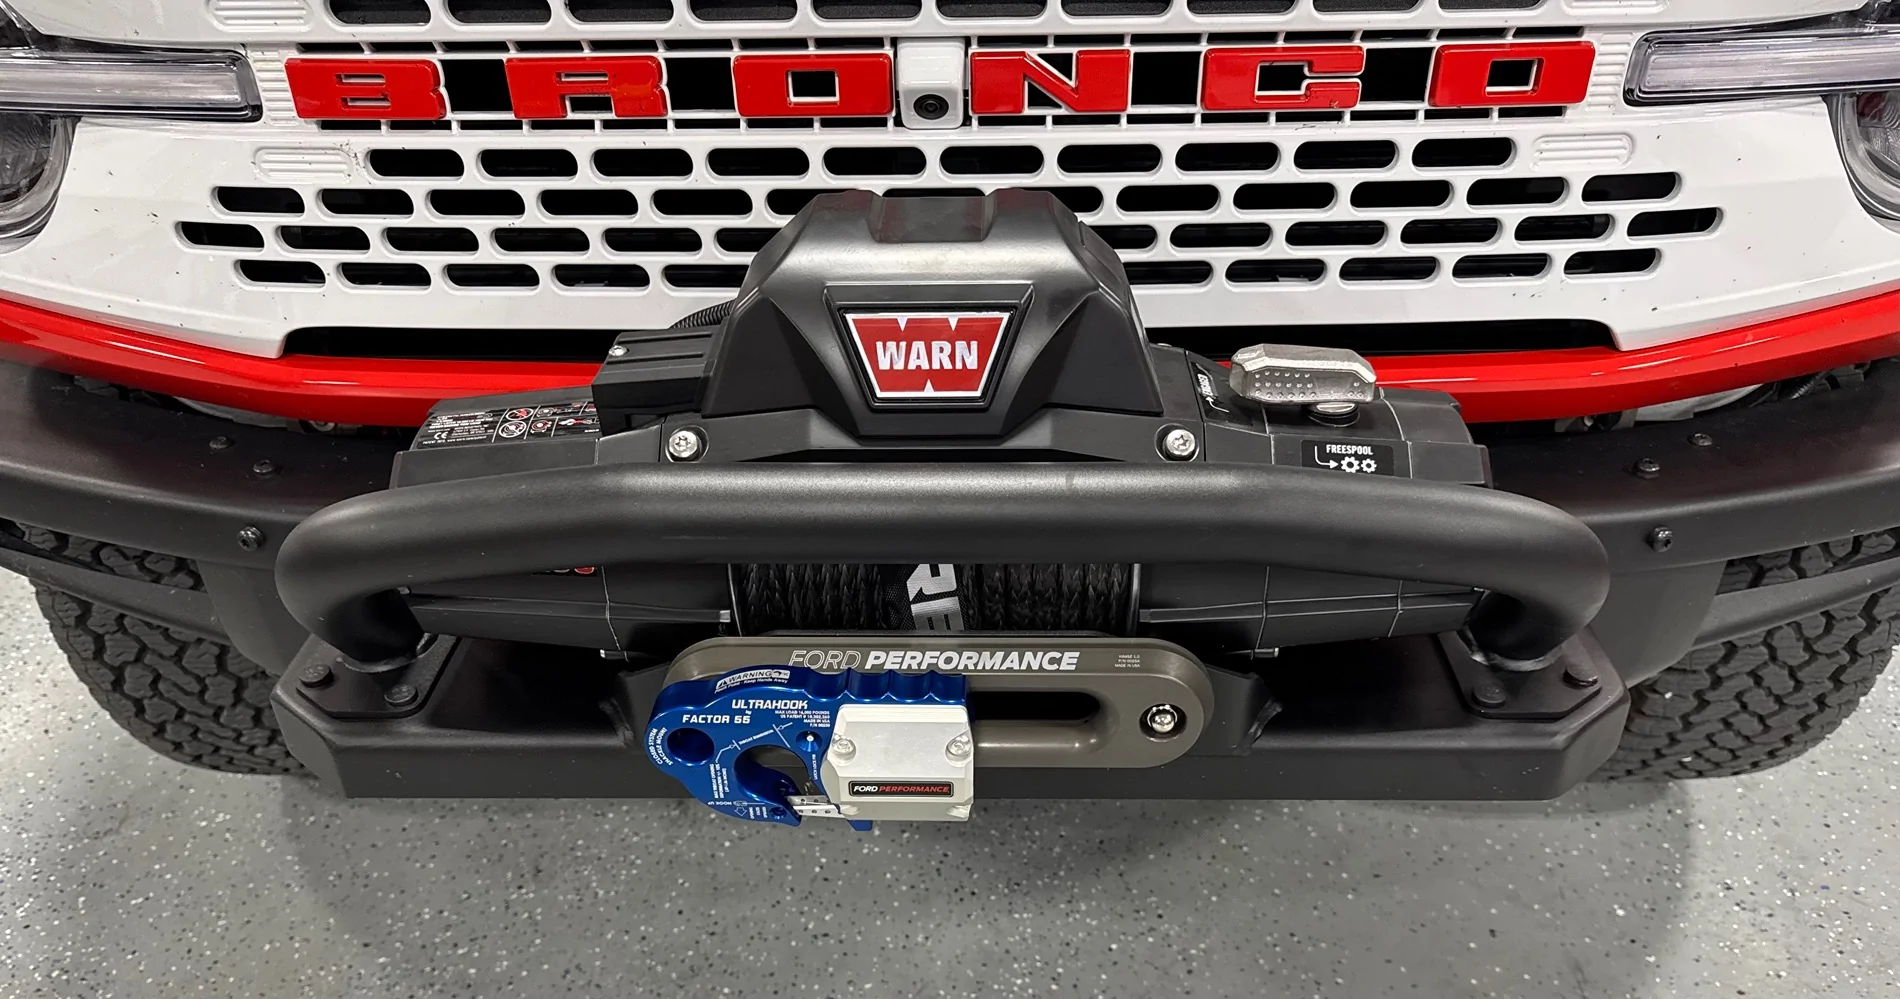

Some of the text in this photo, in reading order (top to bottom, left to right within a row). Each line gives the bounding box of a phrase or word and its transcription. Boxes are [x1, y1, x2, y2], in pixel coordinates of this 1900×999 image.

[287, 42, 1594, 119] BRONCO
[875, 341, 978, 370] WARN
[1326, 444, 1374, 455] FREESPOOL
[788, 650, 1080, 671] FORD PERFORMANCE
[729, 671, 772, 683] WARNING
[731, 699, 808, 709] ULTRAHOOK
[682, 715, 751, 724] FACTOR 55
[879, 785, 950, 793] PERFORMANCE
